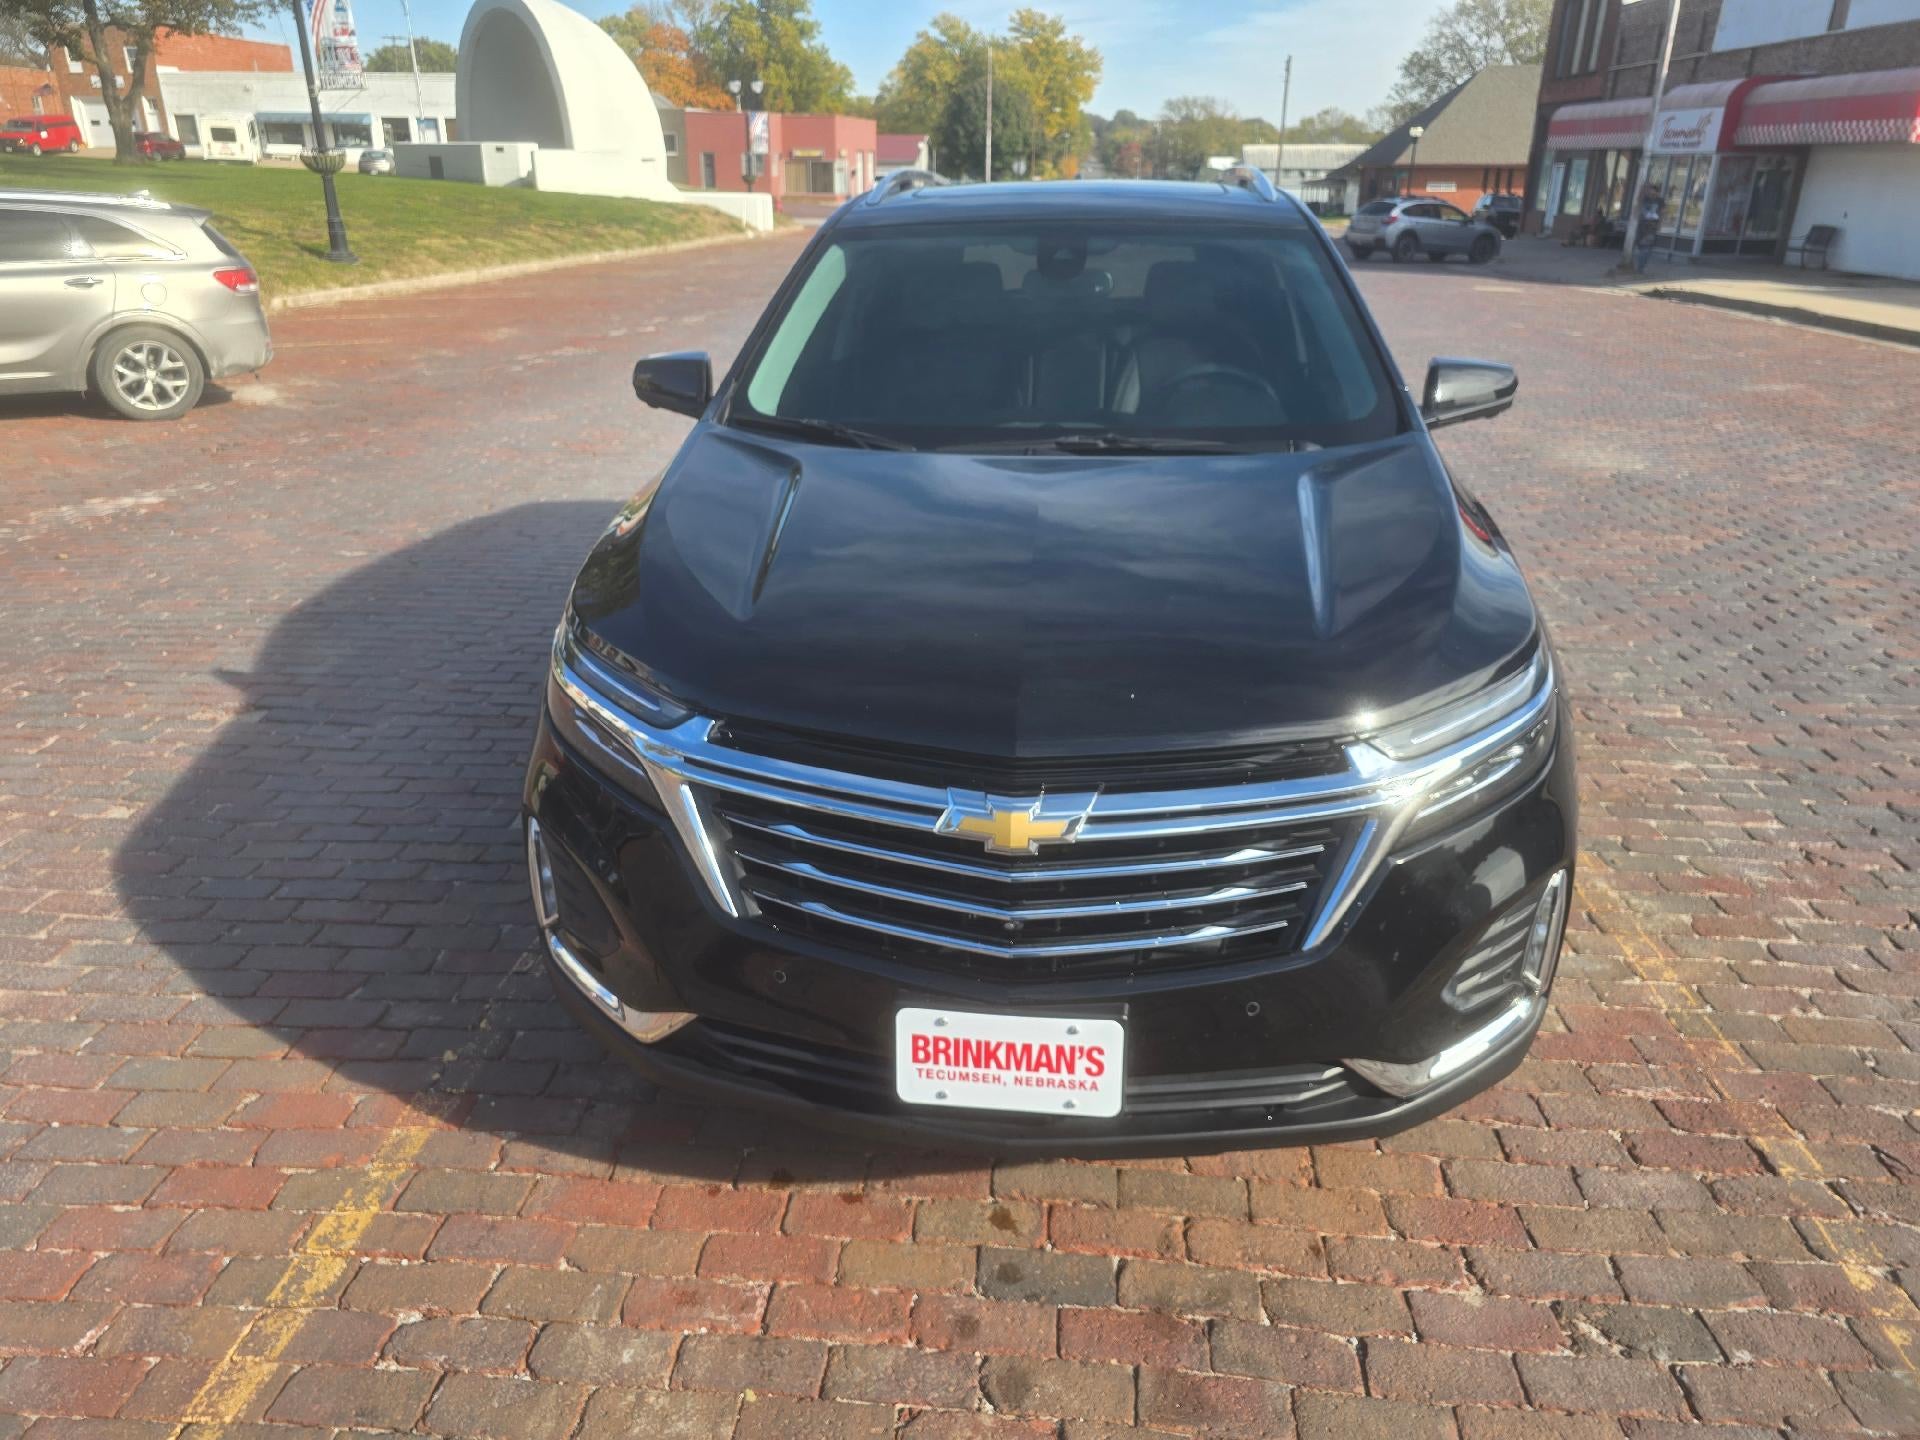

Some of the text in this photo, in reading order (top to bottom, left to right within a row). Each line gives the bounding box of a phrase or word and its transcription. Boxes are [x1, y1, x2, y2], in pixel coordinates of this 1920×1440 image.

[911, 1033, 1105, 1077] BRINKMAN'S
[916, 1068, 1099, 1091] TECUMSEH, NEBRASKA
